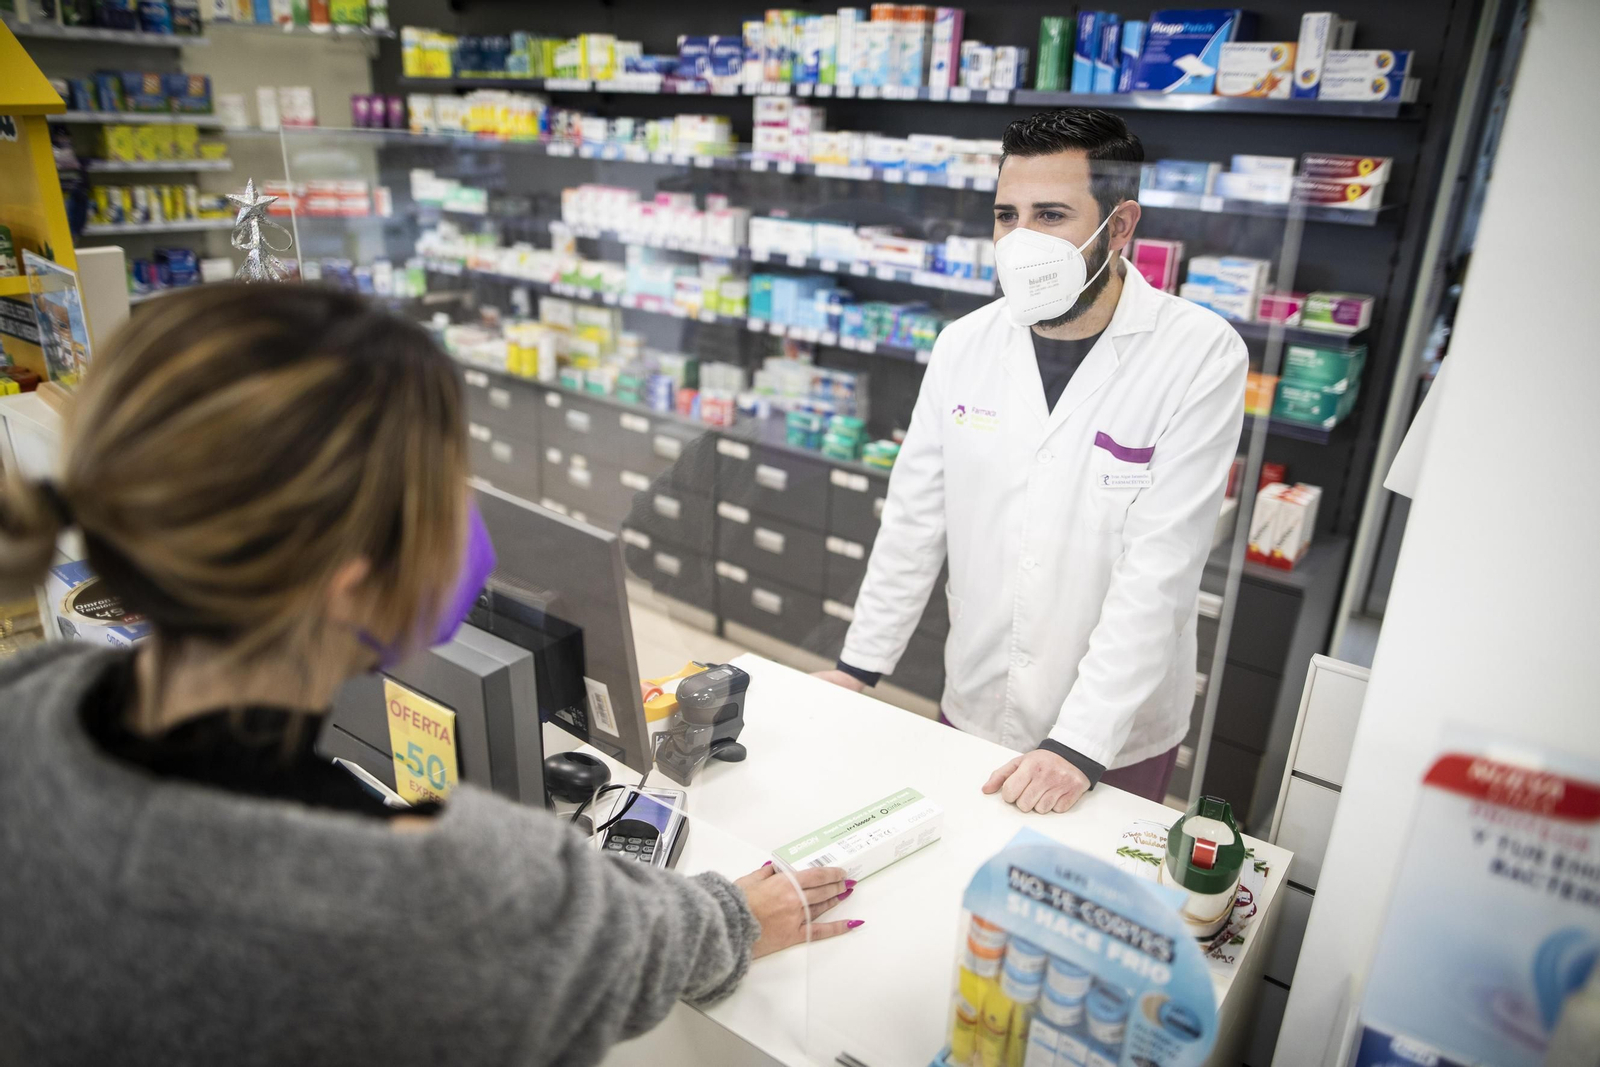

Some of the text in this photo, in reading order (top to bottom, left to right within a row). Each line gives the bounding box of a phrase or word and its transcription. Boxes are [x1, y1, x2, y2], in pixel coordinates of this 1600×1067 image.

[75, 598, 111, 611] Omron
[389, 699, 452, 746] OFERTA
[395, 741, 446, 791] -50
[1006, 892, 1031, 919] SI
[1034, 905, 1101, 952] HACE
[1008, 867, 1173, 963] NO TE CORTES
